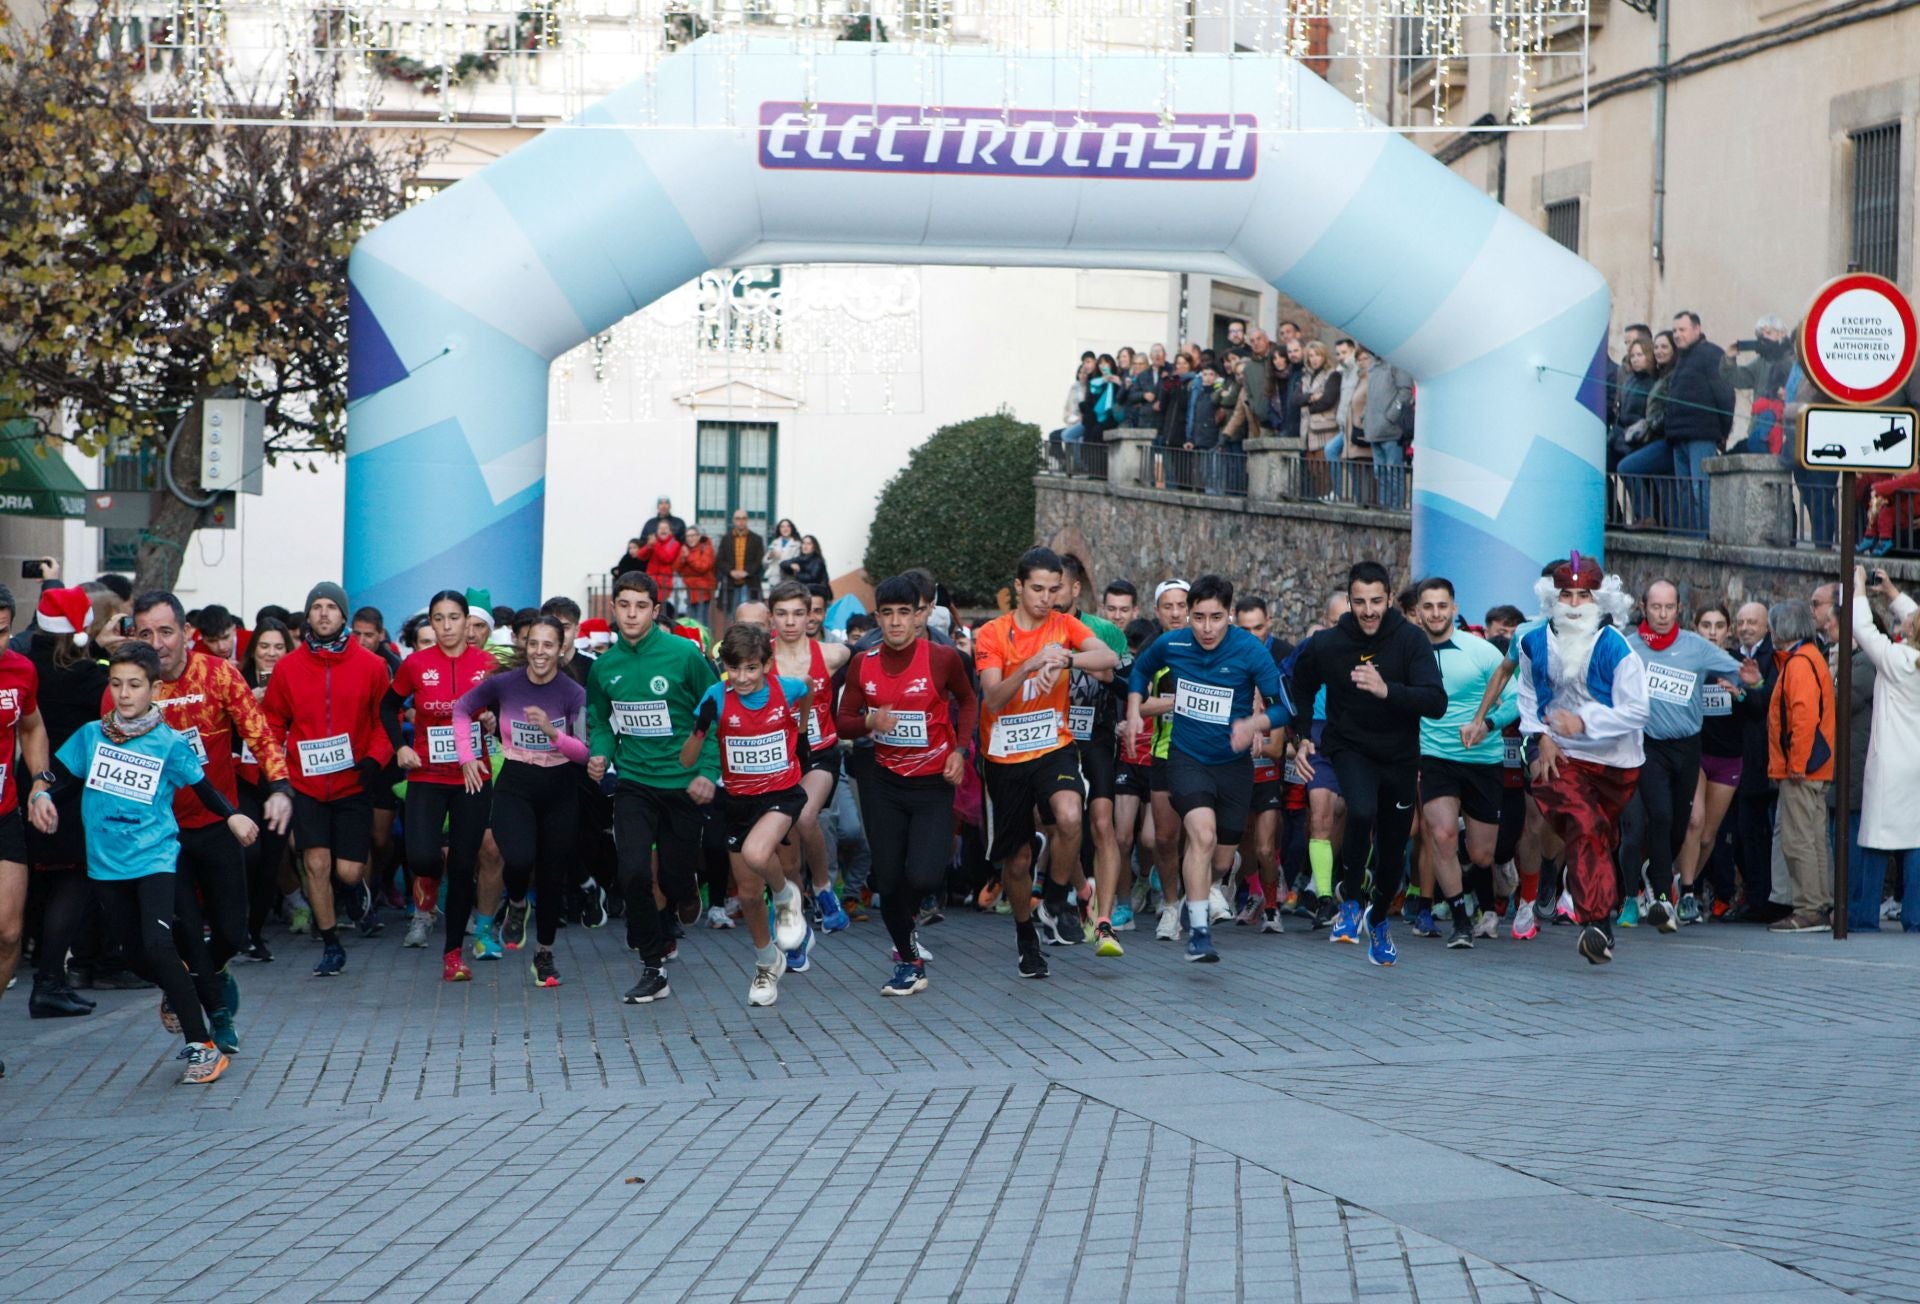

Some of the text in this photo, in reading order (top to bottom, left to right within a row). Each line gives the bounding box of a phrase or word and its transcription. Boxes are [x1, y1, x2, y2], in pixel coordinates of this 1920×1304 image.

[766, 111, 1250, 170] ELECTROCASH
[1841, 317, 1882, 326] EXCEPTO
[1830, 327, 1893, 336] AUTORIZADOS
[1833, 342, 1890, 351] AUTHORIZED
[1825, 352, 1896, 361] VEHICLES ONLY
[1180, 682, 1232, 697] ELECTROCASH
[1648, 676, 1689, 697] 0429
[615, 703, 666, 711] ELECTROCASH
[1187, 696, 1219, 714] 0811
[623, 715, 663, 727] 0103
[1002, 711, 1053, 726] ELECTROCASH
[728, 733, 783, 746] ELECTROCASH
[1006, 724, 1051, 744] 3327
[100, 747, 160, 770] ELECTROCASH
[308, 748, 345, 766] 0418
[732, 747, 782, 764] 0836
[97, 762, 152, 791] 0483
